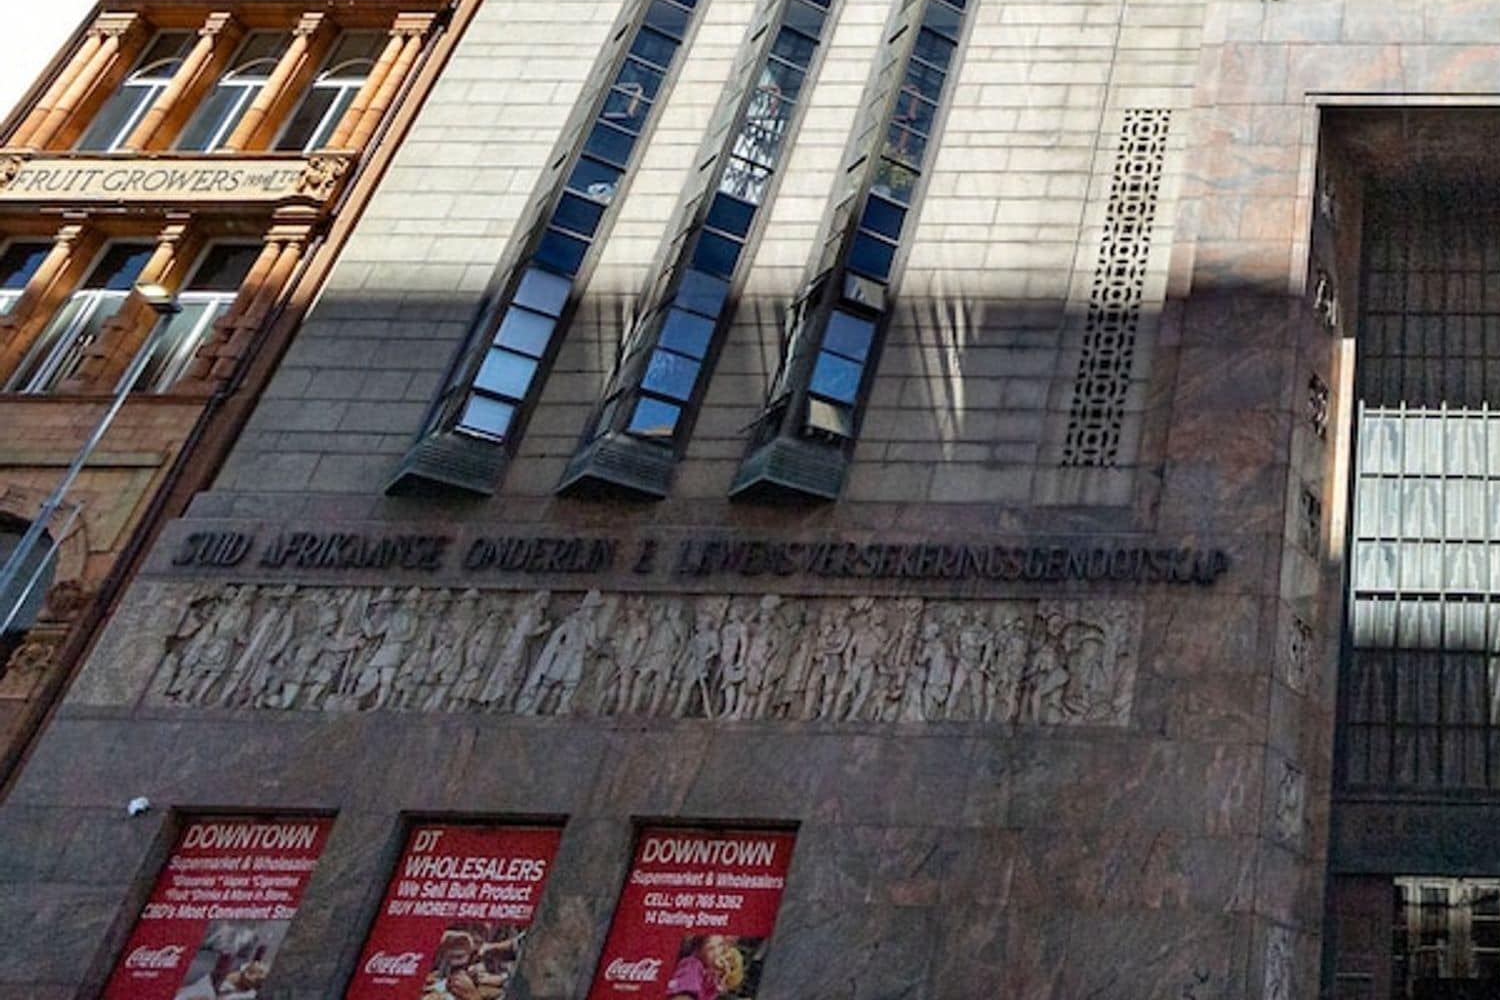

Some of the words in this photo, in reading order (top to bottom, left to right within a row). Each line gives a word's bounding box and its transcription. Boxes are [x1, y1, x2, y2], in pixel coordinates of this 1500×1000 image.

[9, 169, 102, 191] FRUIT
[102, 169, 243, 191] GROWERS
[183, 824, 318, 849] DOWNTOWN
[414, 830, 442, 851] DT
[642, 838, 775, 865] DOWNTOWN
[405, 856, 545, 881] WHOLESALERS
[630, 870, 704, 886] Supermarket
[716, 872, 785, 889] Wholesalers
[420, 880, 448, 899] Sell
[447, 881, 477, 899] Bulk
[478, 883, 532, 902] Product
[271, 906, 298, 920] Stor
[658, 910, 695, 929] Darling
[695, 911, 729, 926] Street
